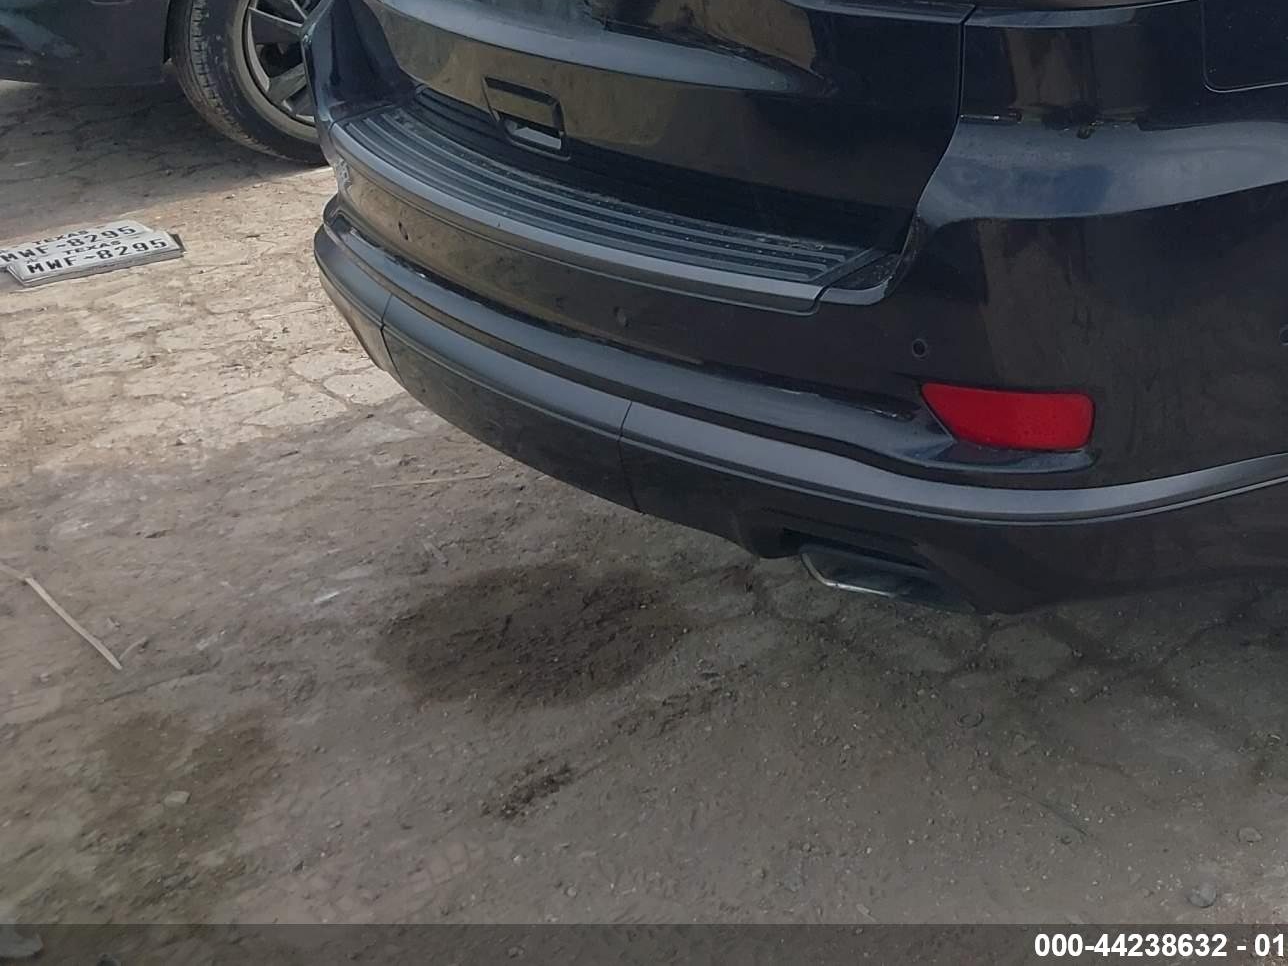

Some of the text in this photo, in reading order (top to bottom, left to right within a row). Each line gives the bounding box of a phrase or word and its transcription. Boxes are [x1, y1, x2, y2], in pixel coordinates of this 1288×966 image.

[33, 230, 89, 245] TEXAS
[64, 240, 121, 255] TEXAS
[27, 238, 168, 274] MWF-8295
